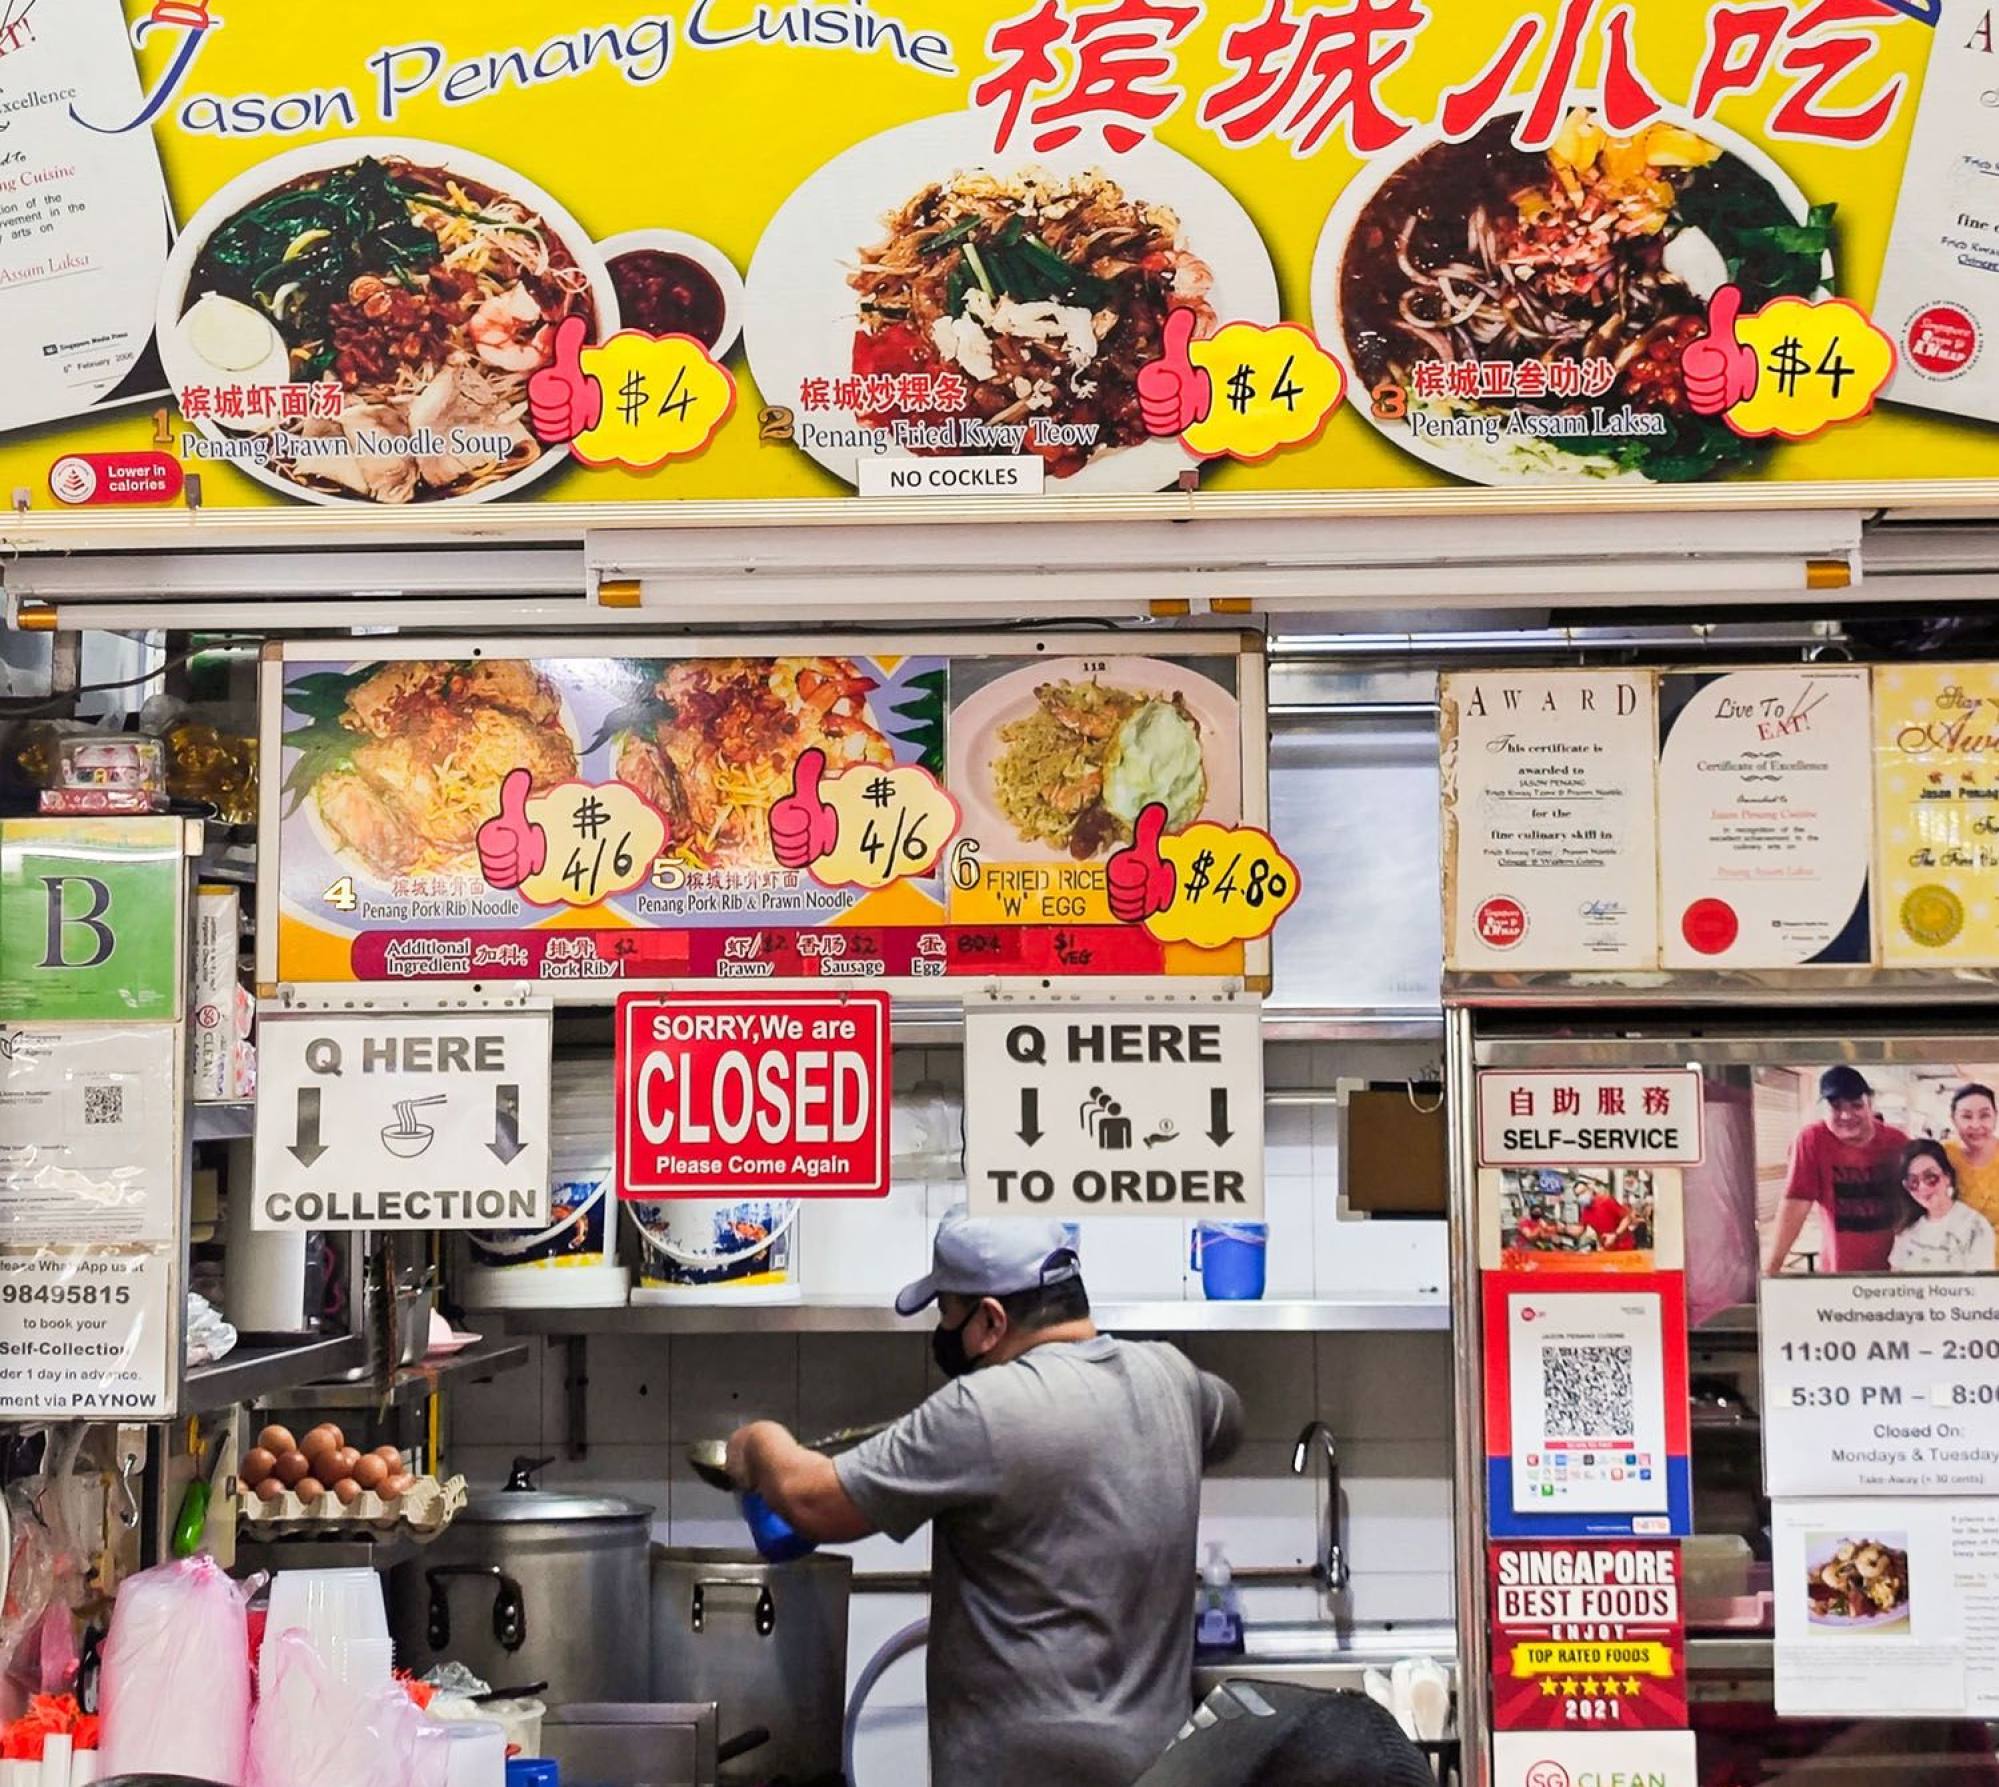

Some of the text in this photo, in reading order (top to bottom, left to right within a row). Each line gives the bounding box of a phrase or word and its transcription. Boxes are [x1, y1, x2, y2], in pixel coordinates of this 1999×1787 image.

[68, 0, 955, 133] Jason Penang Cuisine
[975, 0, 1902, 153] 槟城小吃
[0, 88, 76, 115] xcellence
[20, 165, 76, 187] Cuisine
[44, 193, 62, 204] the
[68, 203, 86, 214] the
[12, 228, 32, 240] arts
[40, 223, 54, 233] on
[1767, 335, 1856, 397] $4
[181, 384, 343, 420] 槟城虾面汤
[800, 374, 967, 413] 槟城炒粿条
[1371, 384, 1408, 420] 3
[152, 408, 174, 443] 1
[759, 406, 795, 440] 2
[1411, 405, 1665, 443] Penang Assam Laksa
[181, 428, 513, 464] Penang Prawn Noodle Soup
[801, 418, 1099, 453] Penang Fried Kway Teow
[108, 464, 166, 478] Lower in
[890, 468, 1018, 487] NO COCKLES
[109, 480, 166, 492] calories
[1715, 697, 1785, 718] Live To
[1757, 711, 1811, 741] EAT!
[1486, 734, 1525, 753] This
[1528, 743, 1590, 753] certificate
[1518, 765, 1584, 775] awarded to
[1697, 760, 1829, 771] Certificate of Excellence
[862, 777, 896, 808] $
[573, 796, 611, 840] $
[1532, 808, 1571, 818] for the
[860, 806, 929, 878] 4/6
[1491, 829, 1612, 842] fine culinary skill in
[562, 831, 633, 896] 4/6
[651, 858, 686, 891] 5
[952, 838, 981, 889] 6
[987, 869, 1105, 891] FRIED RICE
[1184, 849, 1288, 908] $4.80
[323, 876, 357, 912] 4
[638, 891, 854, 914] Penang Pork Rib & Prawn Noodle
[362, 899, 520, 920] Penang Pork Rib Noodle
[1042, 896, 1086, 917] EGG
[34, 876, 116, 969] B
[385, 938, 470, 956] Additional
[387, 958, 469, 975] Ingredient
[540, 961, 578, 977] Pork
[821, 959, 884, 976] Sausage
[203, 1007, 215, 1025] SG
[812, 1020, 856, 1040] are
[305, 1035, 506, 1077] Q HERE
[1006, 1025, 1223, 1066] Q HERE
[637, 1050, 870, 1145] CLOSED
[1509, 1085, 1671, 1117] 自助服務
[1503, 1127, 1679, 1150] SELF-SERVICE
[655, 1156, 850, 1177] Please Come Again
[987, 1170, 1247, 1204] TO ORDER
[264, 1188, 537, 1222] COLLECTION
[2, 1284, 130, 1304] 98495815
[1851, 1284, 1975, 1300] Operating Hours:
[23, 1317, 107, 1332] to book your
[1816, 1307, 1924, 1325] Wednesdays
[1929, 1307, 1946, 1320] to
[1780, 1339, 1999, 1361] 11:00 AM 2:00
[28, 1369, 77, 1383] 1 day in
[44, 1394, 67, 1407] via
[71, 1393, 157, 1408] PAYNOW
[1791, 1386, 1902, 1406] 5:30 PM
[1873, 1424, 1931, 1438] Closed
[1831, 1449, 1906, 1466] Mondays
[1912, 1449, 1924, 1463] &
[1499, 1550, 1676, 1584] SINGAPORE
[1505, 1589, 1670, 1617] BEST FOODS
[1551, 1623, 1626, 1641] ENJOY
[1527, 1648, 1650, 1663] TOP RATED FOODS
[1565, 1699, 1620, 1720] 2021
[1532, 1772, 1667, 1787] SG CLEAN
